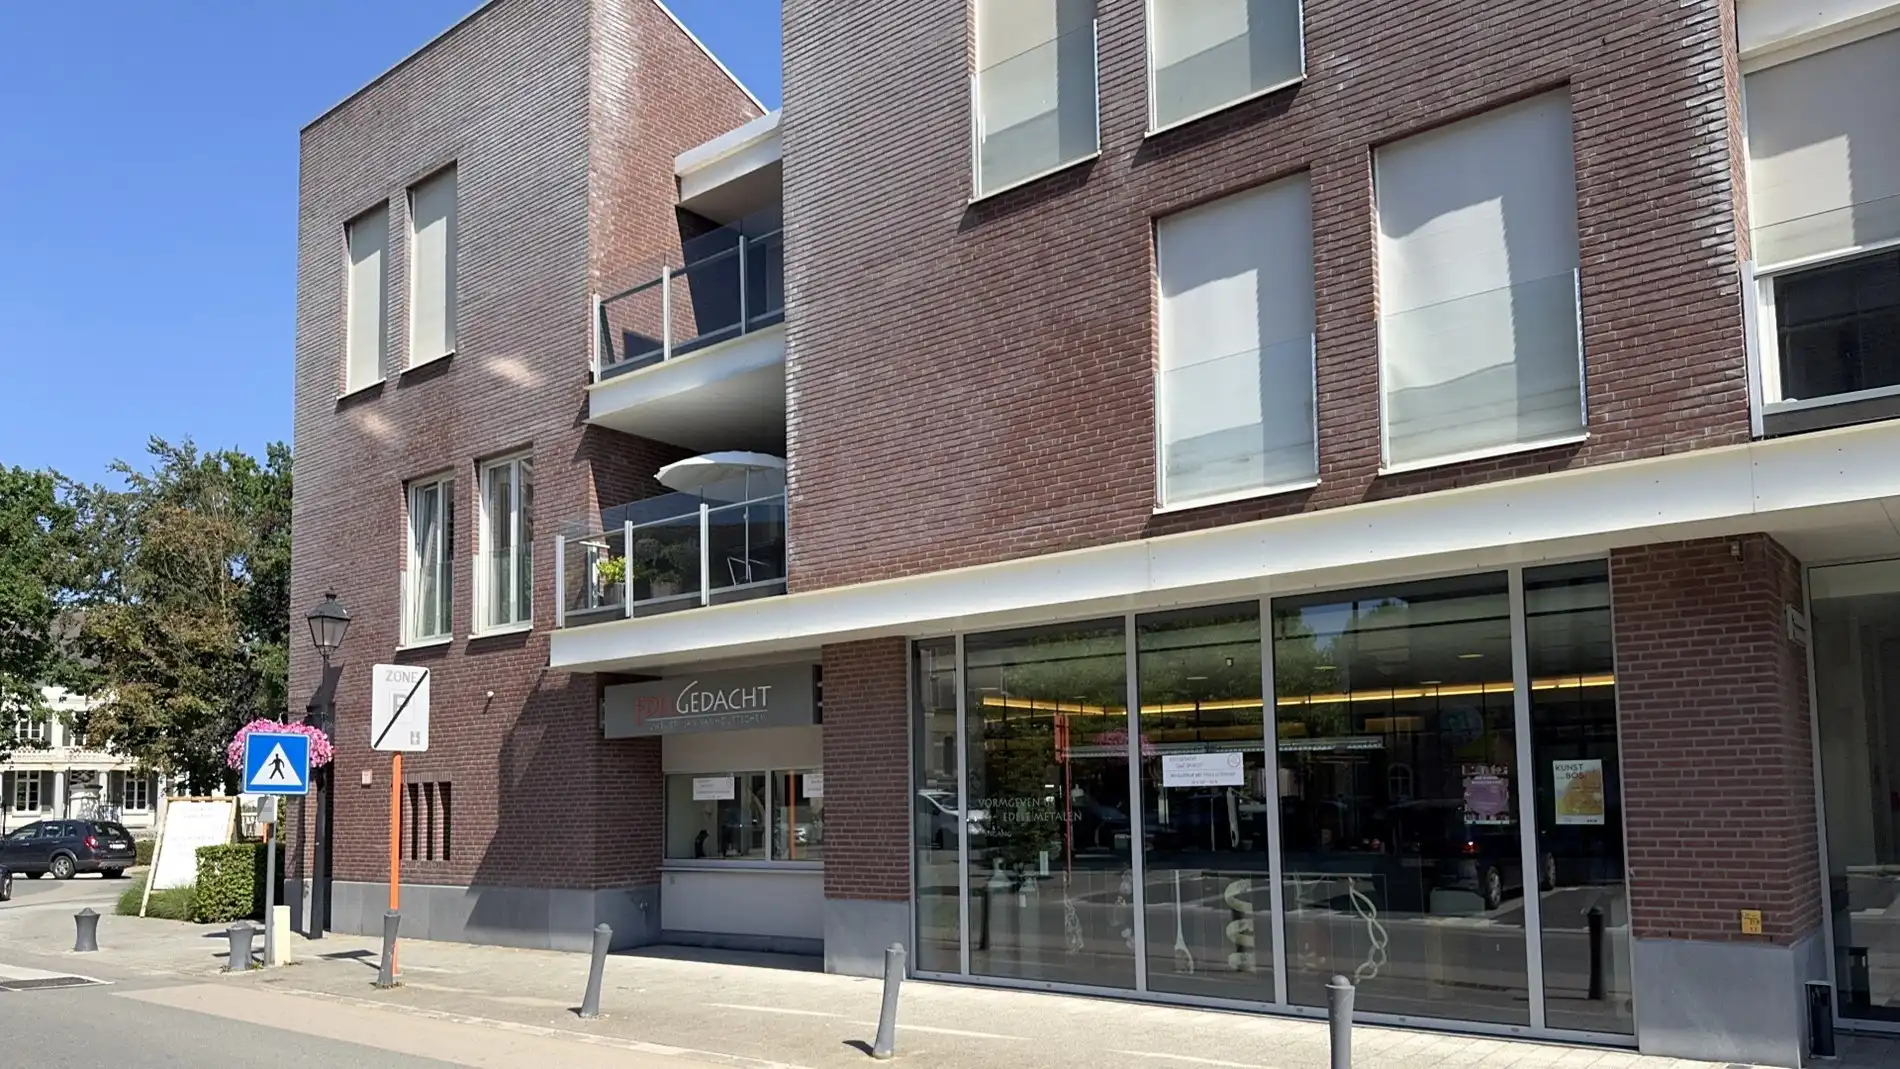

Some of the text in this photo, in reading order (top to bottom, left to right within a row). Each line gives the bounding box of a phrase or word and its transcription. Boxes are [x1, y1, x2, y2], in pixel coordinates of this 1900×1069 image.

[386, 669, 418, 683] ZONE
[1555, 763, 1584, 772] KUNST
[1566, 771, 1585, 780] BOS
[978, 797, 1040, 808] VORMGEVEN
[1033, 811, 1082, 822] METALEN
